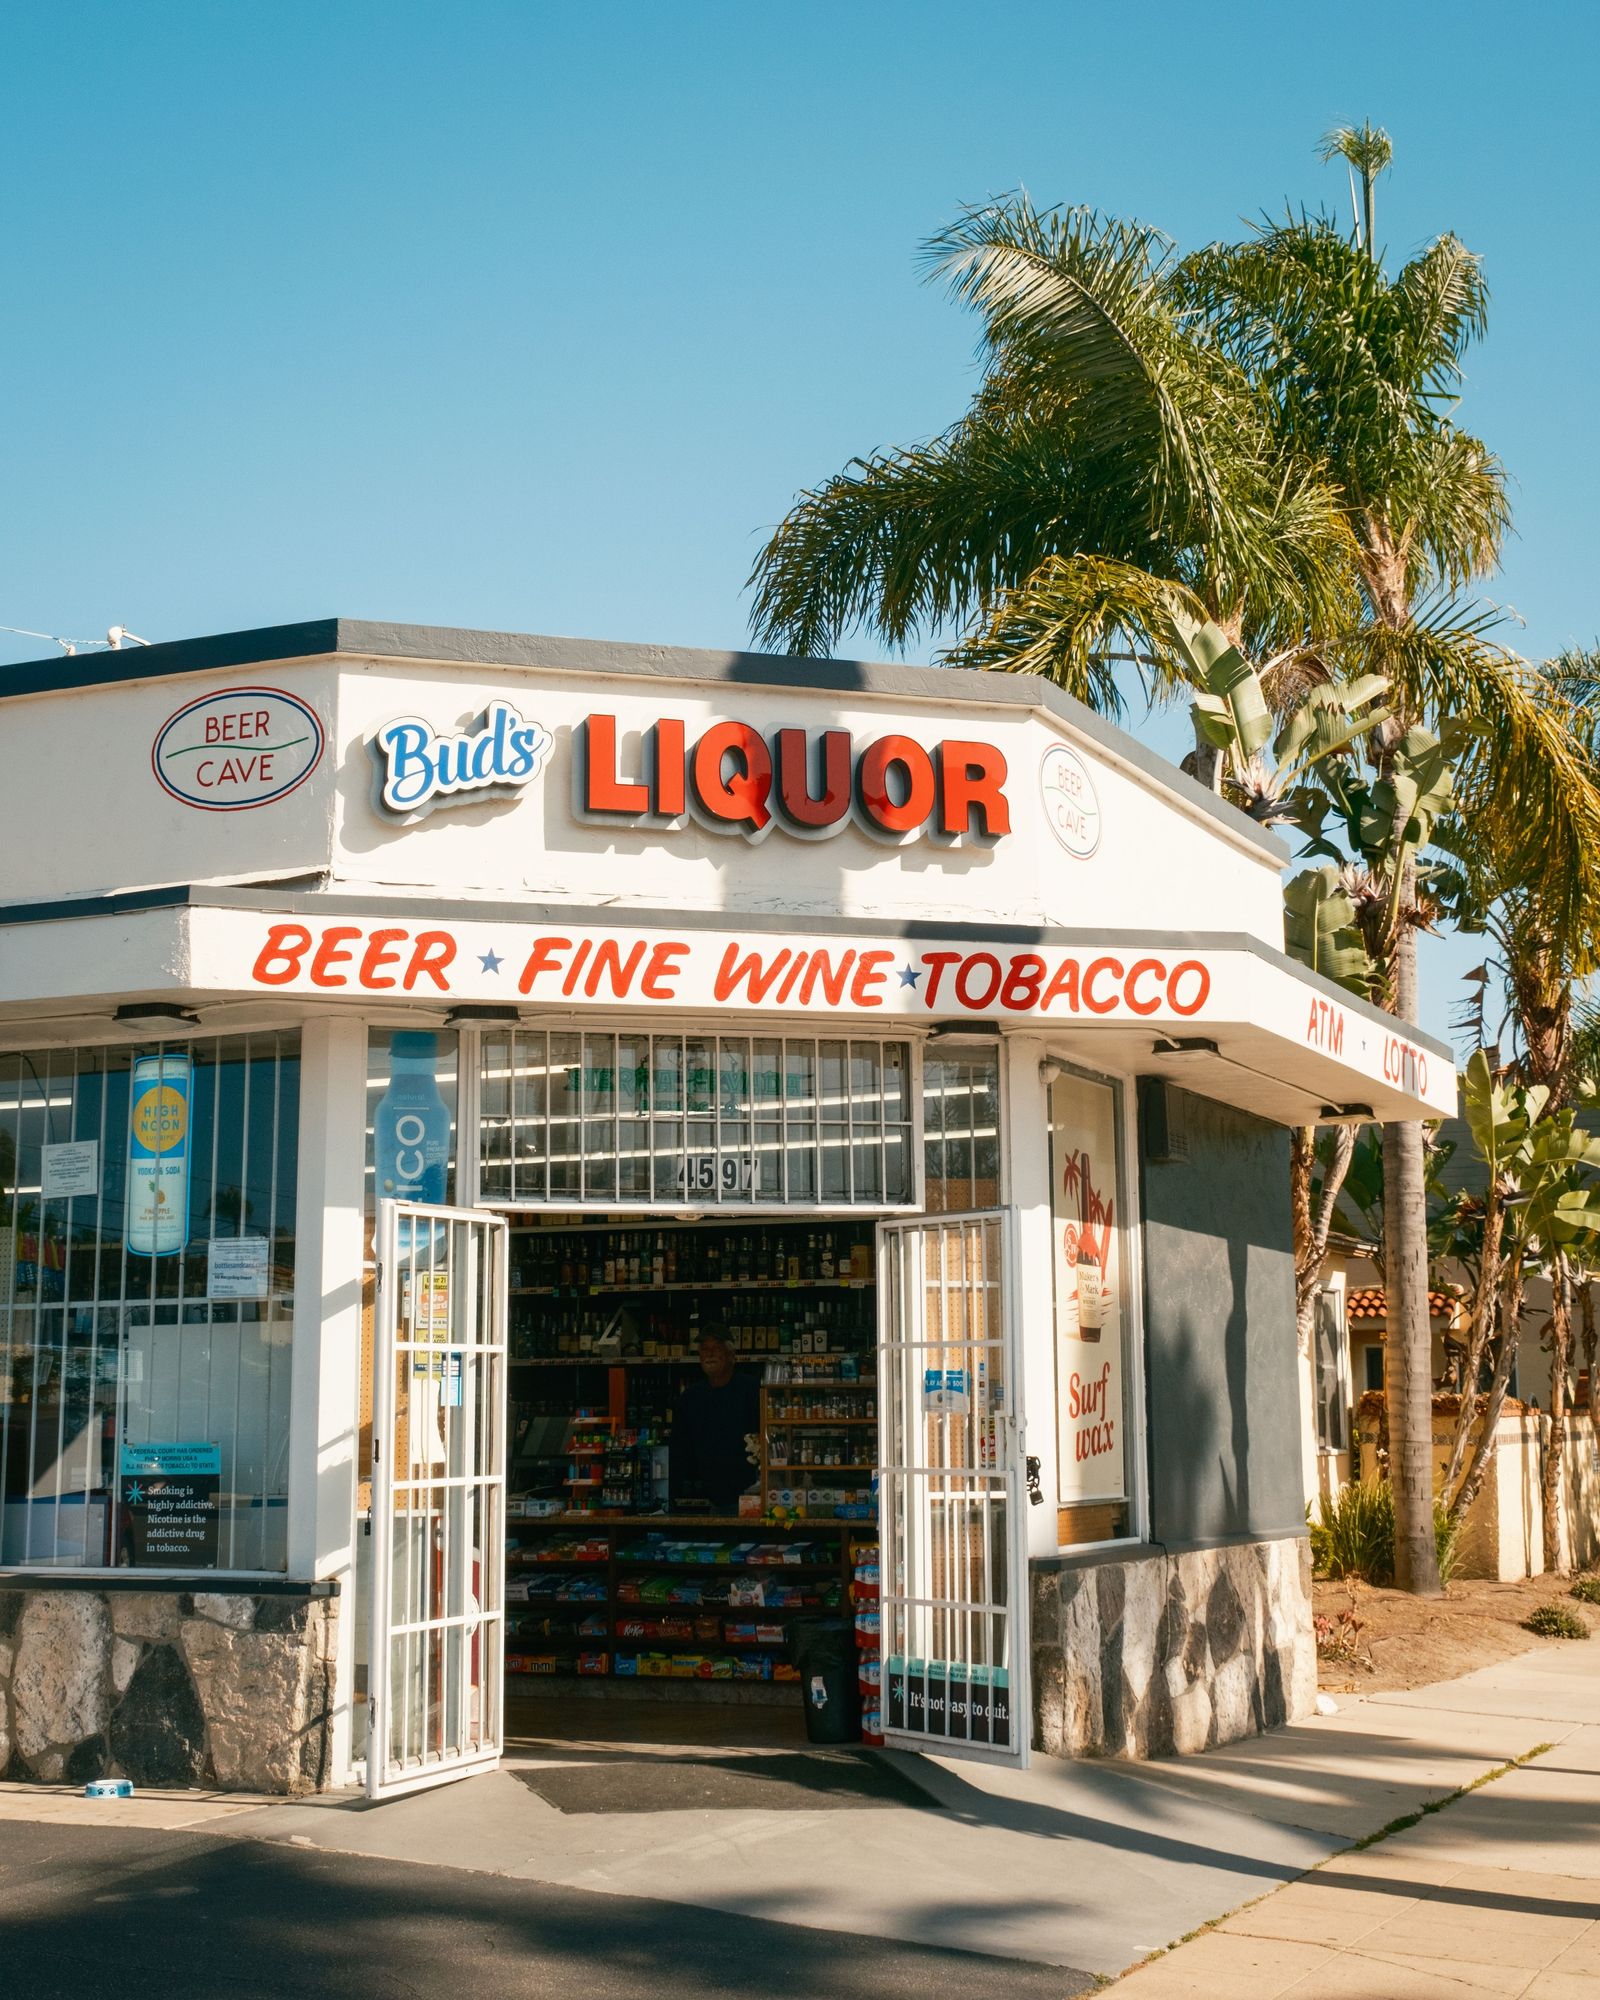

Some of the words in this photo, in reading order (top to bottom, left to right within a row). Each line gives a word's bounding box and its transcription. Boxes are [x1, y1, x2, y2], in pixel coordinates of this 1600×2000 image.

[205, 710, 270, 743] BEER
[196, 754, 275, 787] CAVE
[385, 708, 545, 803] Bud's
[585, 714, 1012, 834] LIQUOR
[1058, 764, 1083, 799] BEER
[1057, 804, 1087, 840] CAVE
[252, 924, 457, 992] BEER
[518, 937, 691, 1000] FINE
[714, 942, 896, 1006] WINE
[921, 951, 1211, 1016] TOBACCO
[1307, 996, 1344, 1057] ATM
[1383, 1034, 1428, 1096] LOTTO
[144, 1104, 179, 1118] HIGH
[678, 1158, 759, 1189] 4597
[1069, 1361, 1111, 1422] Surf
[1075, 1419, 1115, 1462] wax
[147, 1485, 185, 1498] Smoking
[186, 1485, 194, 1495] is
[147, 1500, 174, 1512] highly
[175, 1500, 216, 1510] addictive.
[146, 1528, 185, 1538] addictive
[185, 1528, 206, 1541] drug
[147, 1514, 183, 1524] Nicotine
[183, 1514, 191, 1524] is
[192, 1514, 207, 1524] the
[146, 1542, 155, 1552] in
[156, 1542, 190, 1553] tobacco.
[910, 1691, 925, 1709] It's
[929, 1698, 945, 1712] not
[947, 1701, 968, 1718] asy
[970, 1701, 983, 1716] to
